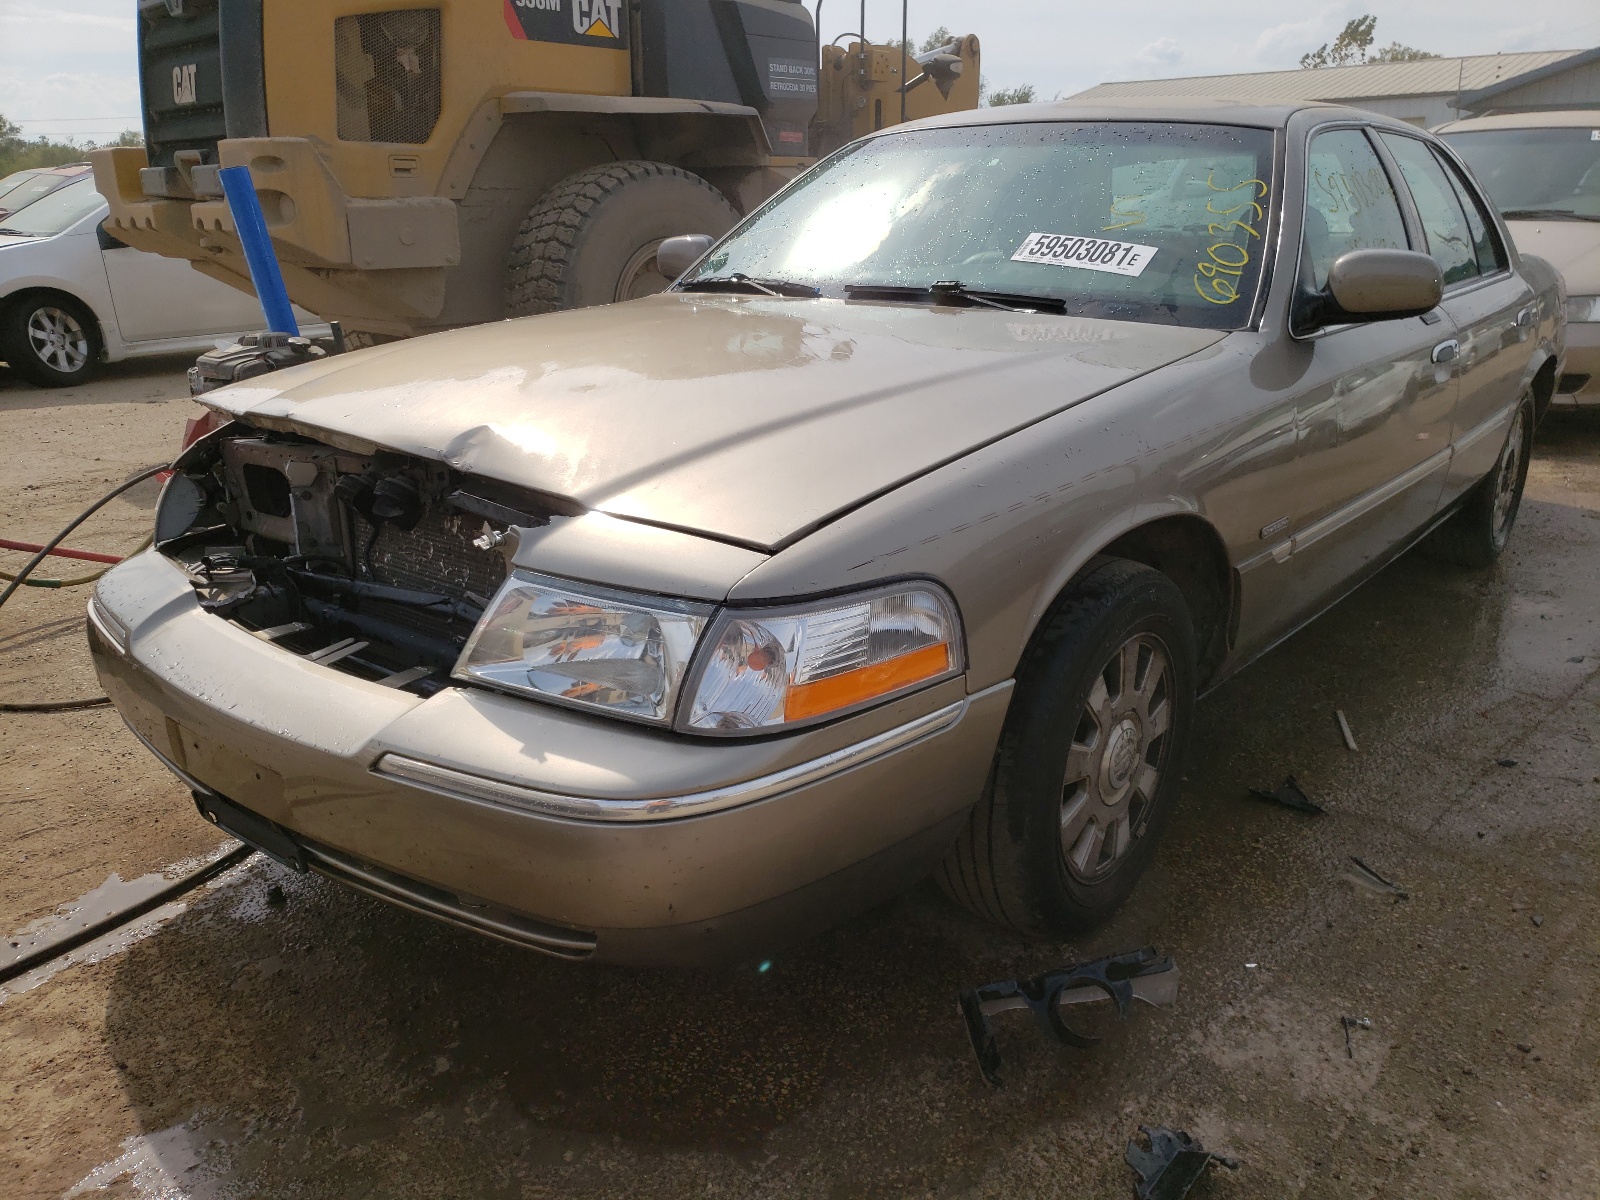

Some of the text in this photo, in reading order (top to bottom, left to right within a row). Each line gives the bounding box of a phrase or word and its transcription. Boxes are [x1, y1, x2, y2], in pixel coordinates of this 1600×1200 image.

[572, 0, 622, 38] CAT
[769, 64, 788, 73] STAND
[788, 65, 803, 75] BACK
[172, 64, 197, 105] CAT
[799, 84, 806, 92] 30
[806, 84, 817, 93] PIES
